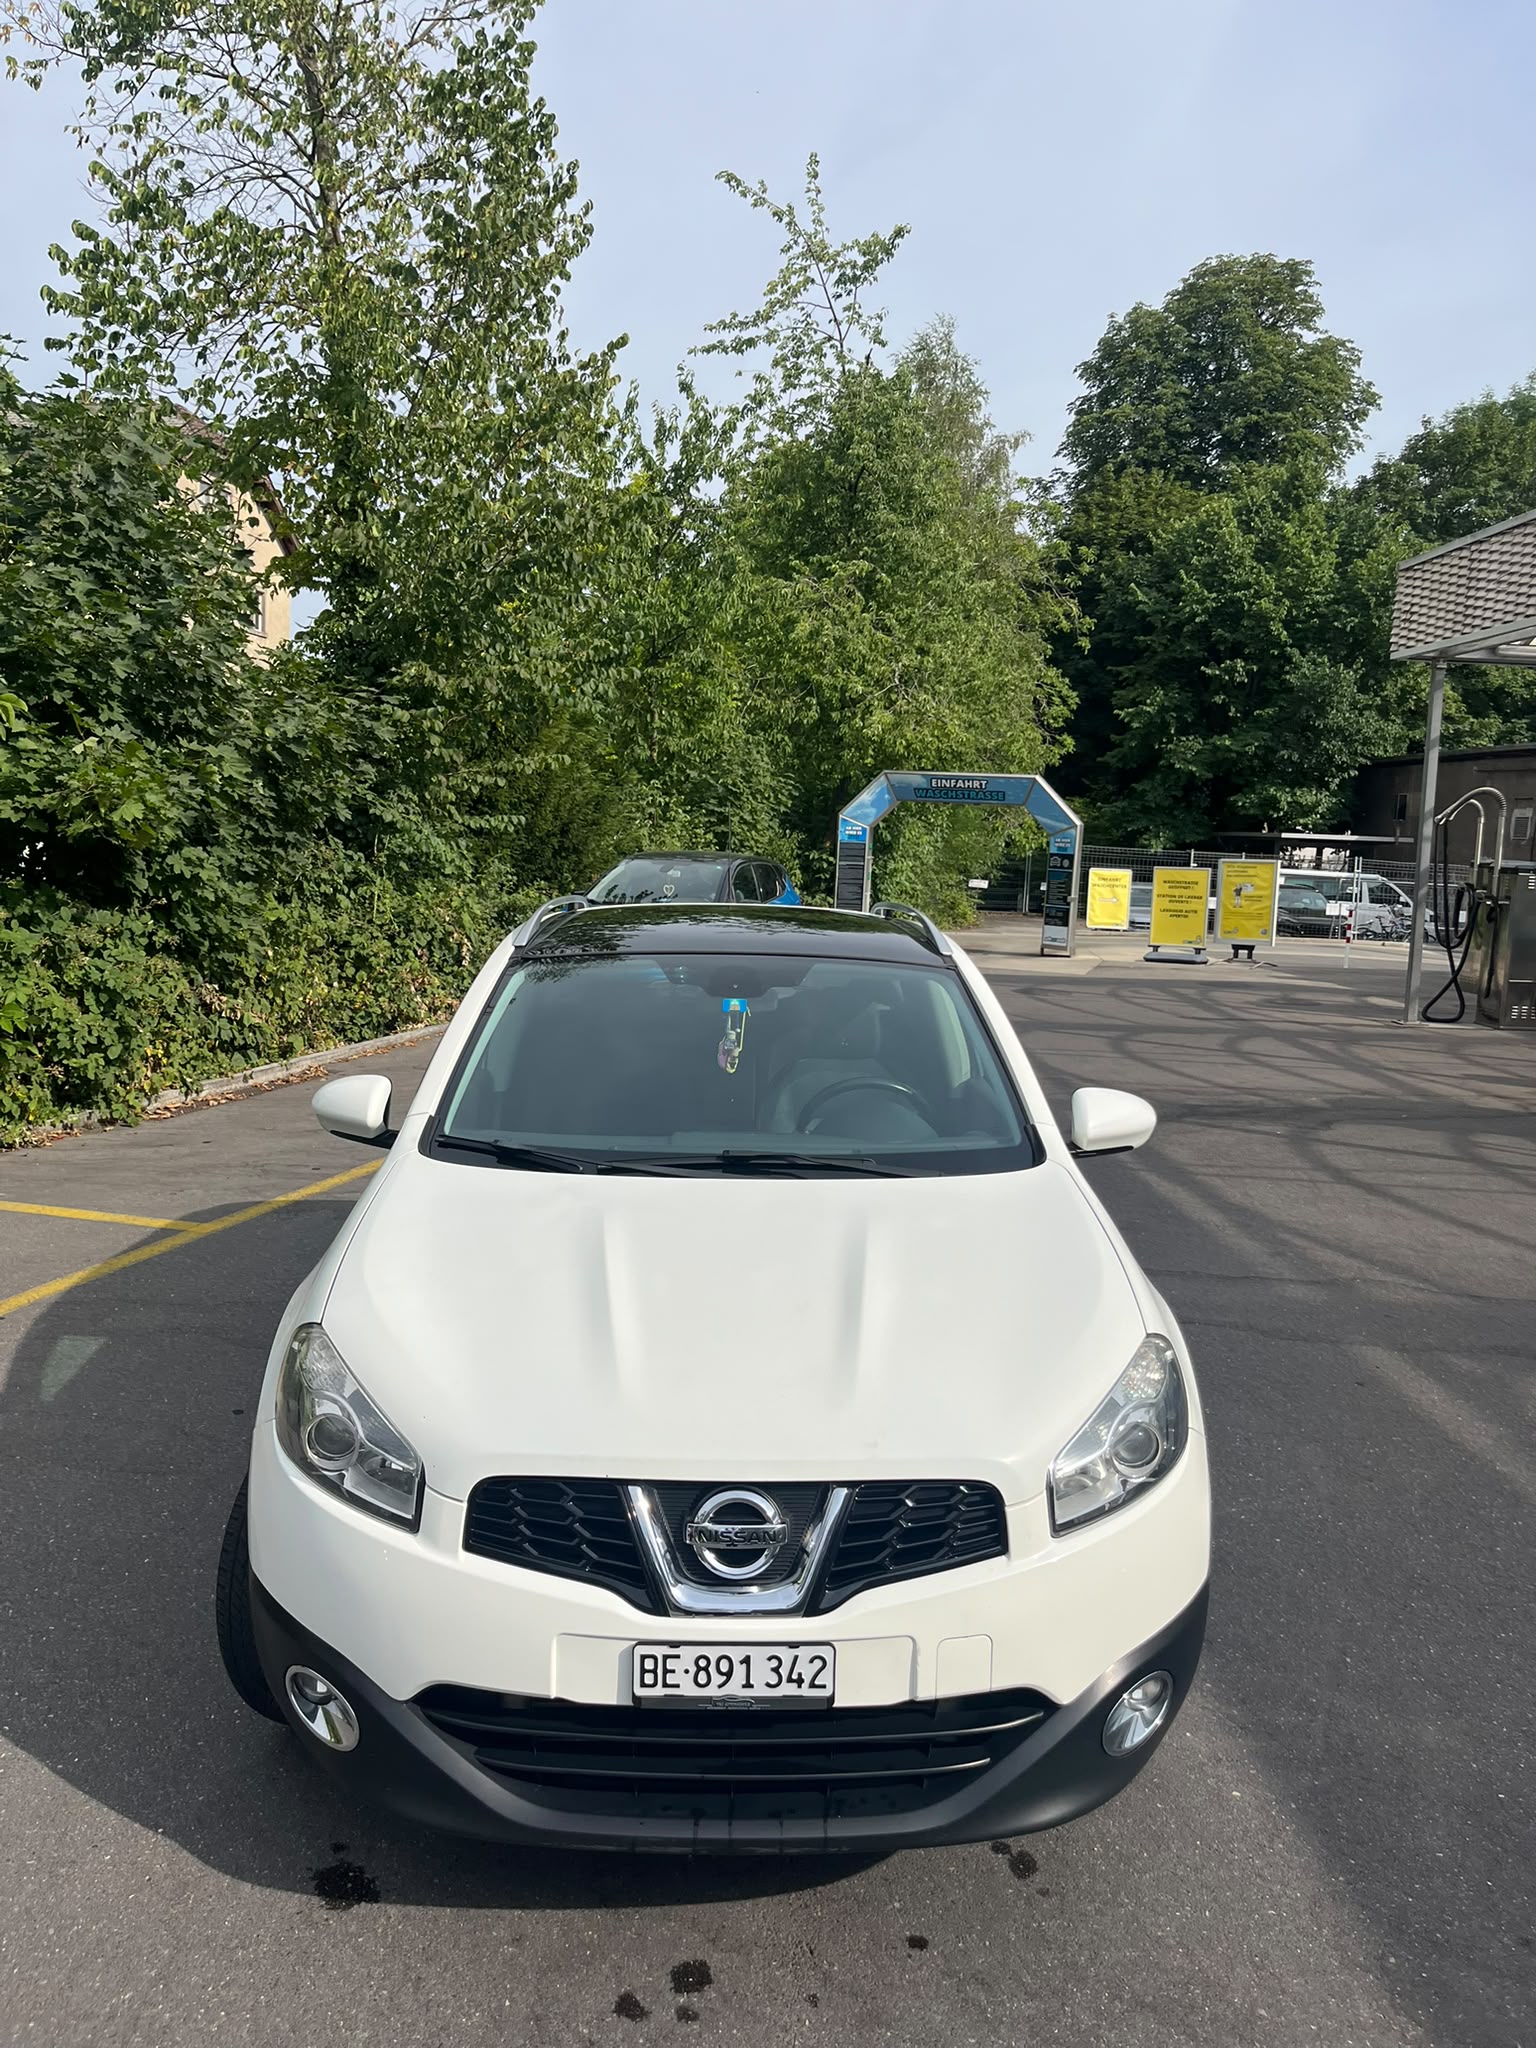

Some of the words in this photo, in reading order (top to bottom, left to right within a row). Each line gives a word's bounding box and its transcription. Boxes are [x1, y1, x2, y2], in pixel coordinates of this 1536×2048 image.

[931, 778, 988, 789] EINFAHRT
[915, 789, 1004, 800] WASCHSTRASSE
[696, 1530, 777, 1544] NISSAN
